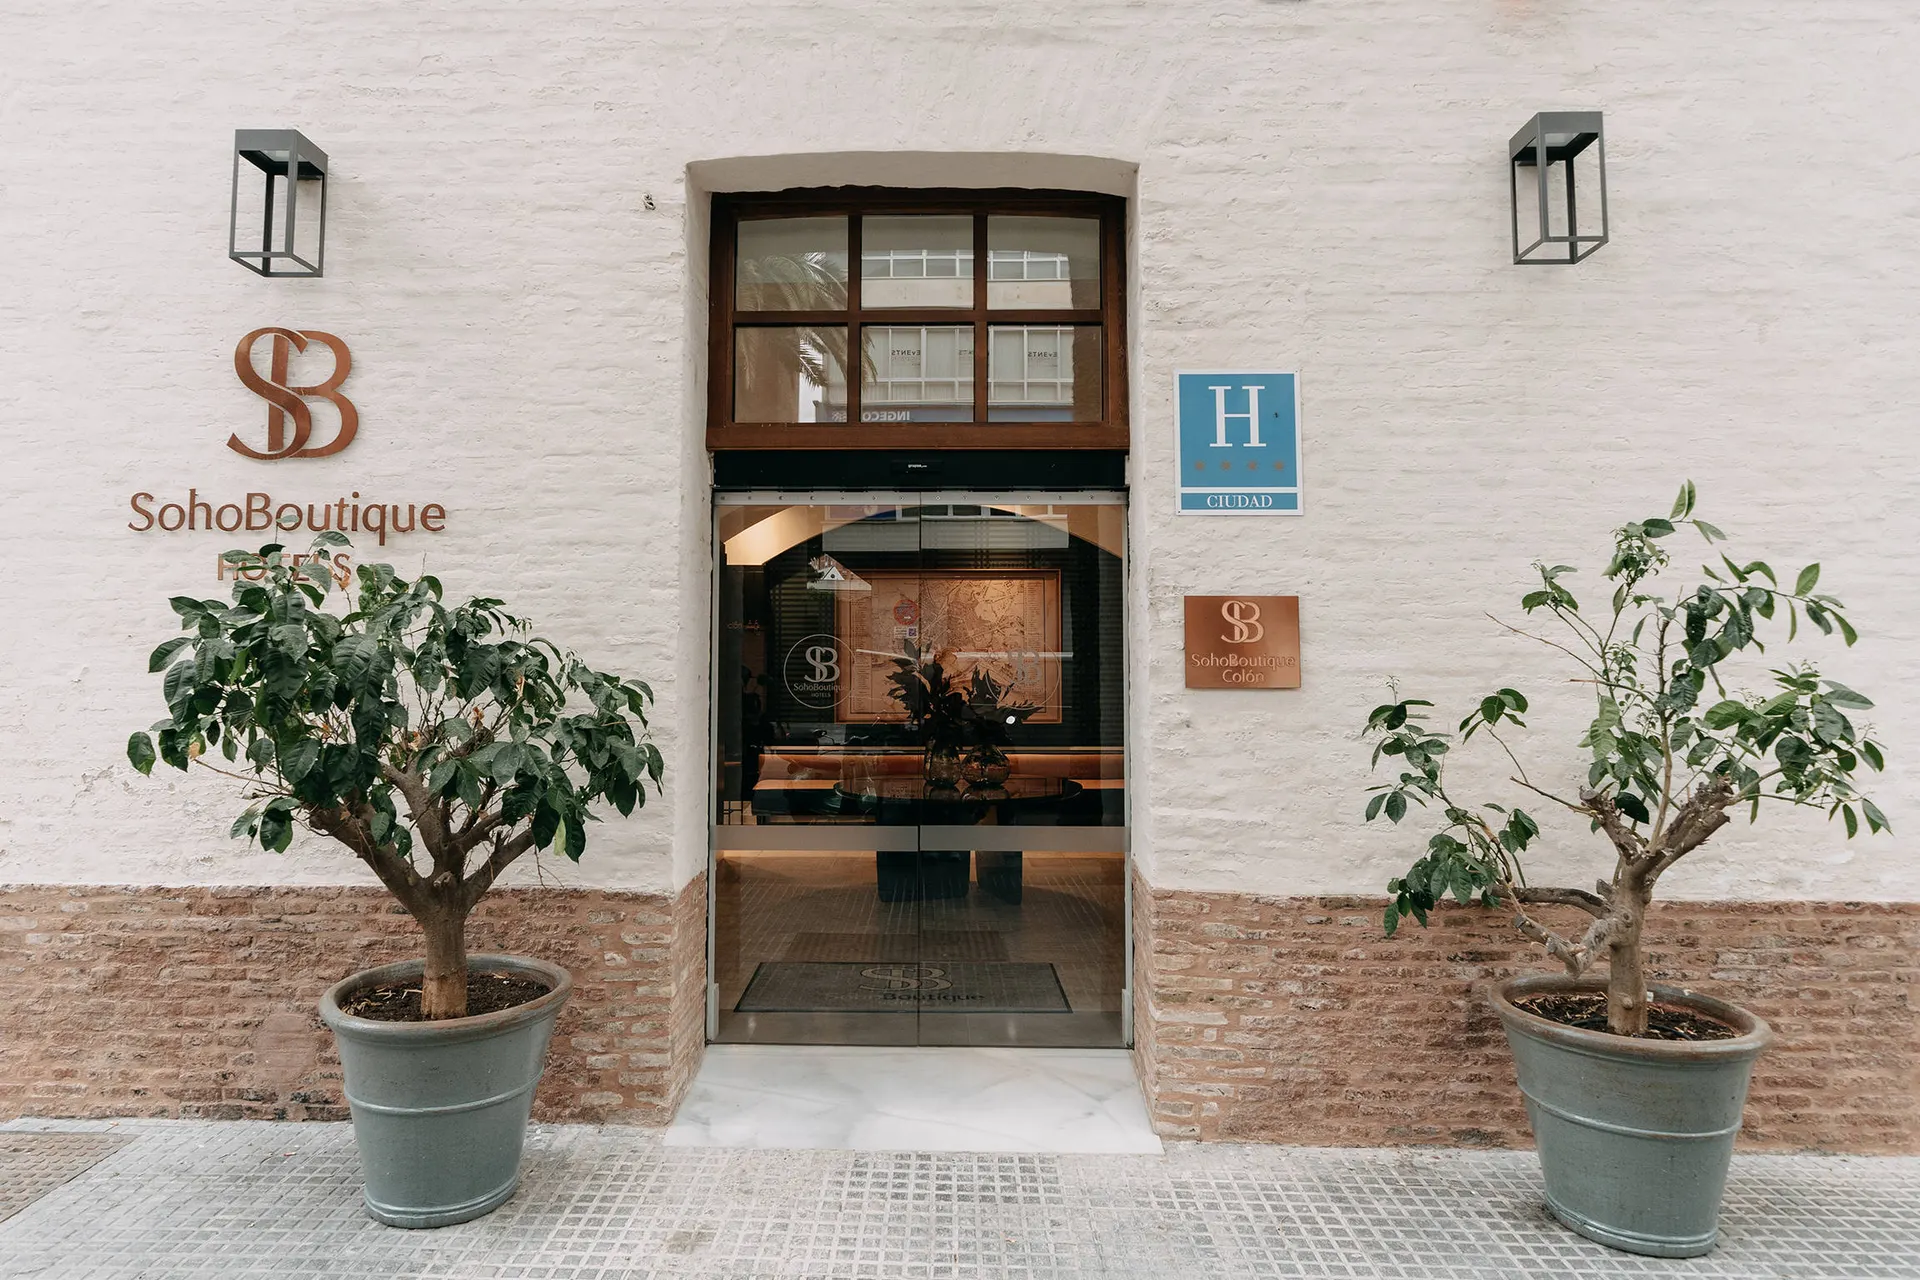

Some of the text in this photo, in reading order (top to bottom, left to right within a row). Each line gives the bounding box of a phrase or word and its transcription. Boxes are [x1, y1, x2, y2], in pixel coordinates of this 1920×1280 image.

[226, 326, 360, 461] SB
[1208, 385, 1267, 447] H
[128, 488, 447, 547] SohoBoutique
[1206, 494, 1273, 508] CIUDAD
[1191, 652, 1296, 671] SohoBoutique
[1222, 669, 1265, 683] Colón
